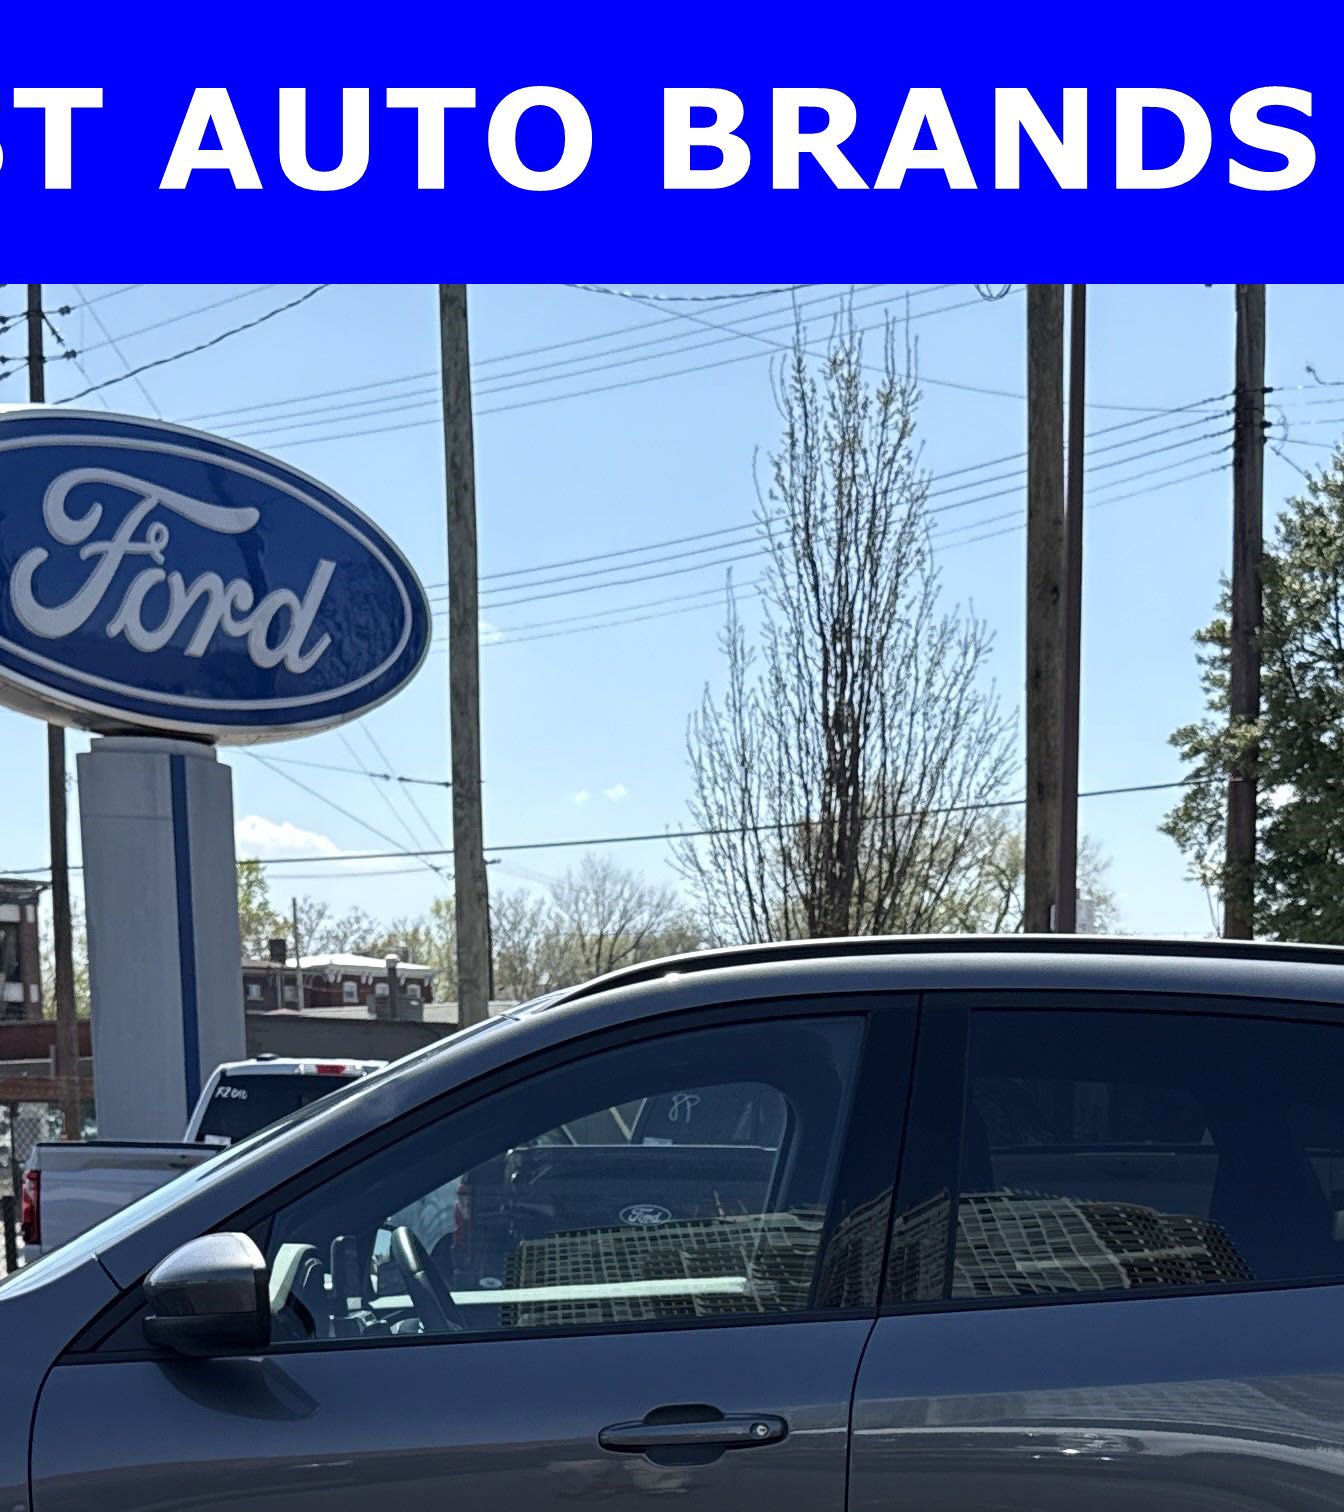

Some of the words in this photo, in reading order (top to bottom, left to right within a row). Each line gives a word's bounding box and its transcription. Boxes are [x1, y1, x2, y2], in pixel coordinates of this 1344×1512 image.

[10, 467, 338, 674] Ford
[668, 1093, 701, 1123] 8P
[627, 1208, 662, 1223] Ford
